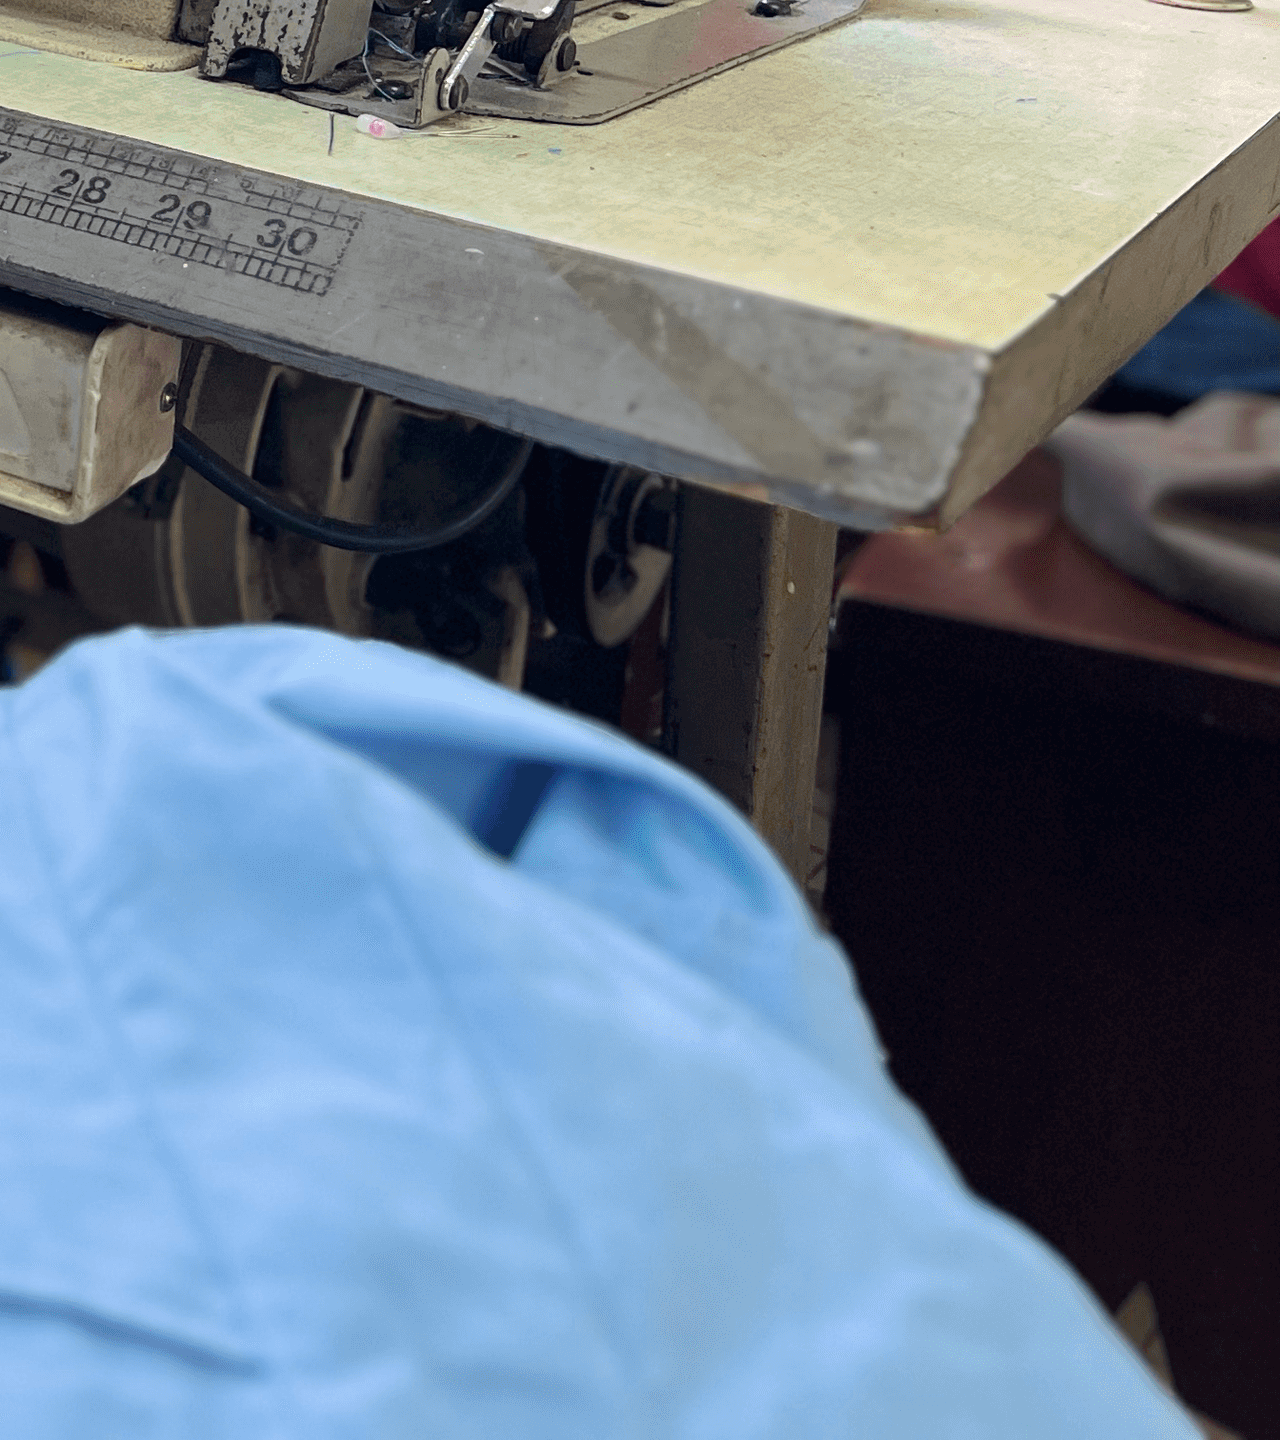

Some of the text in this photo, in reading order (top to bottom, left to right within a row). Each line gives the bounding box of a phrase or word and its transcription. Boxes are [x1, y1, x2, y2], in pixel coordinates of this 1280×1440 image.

[50, 168, 112, 205] 28
[150, 193, 213, 230] 29
[256, 218, 318, 256] 30
